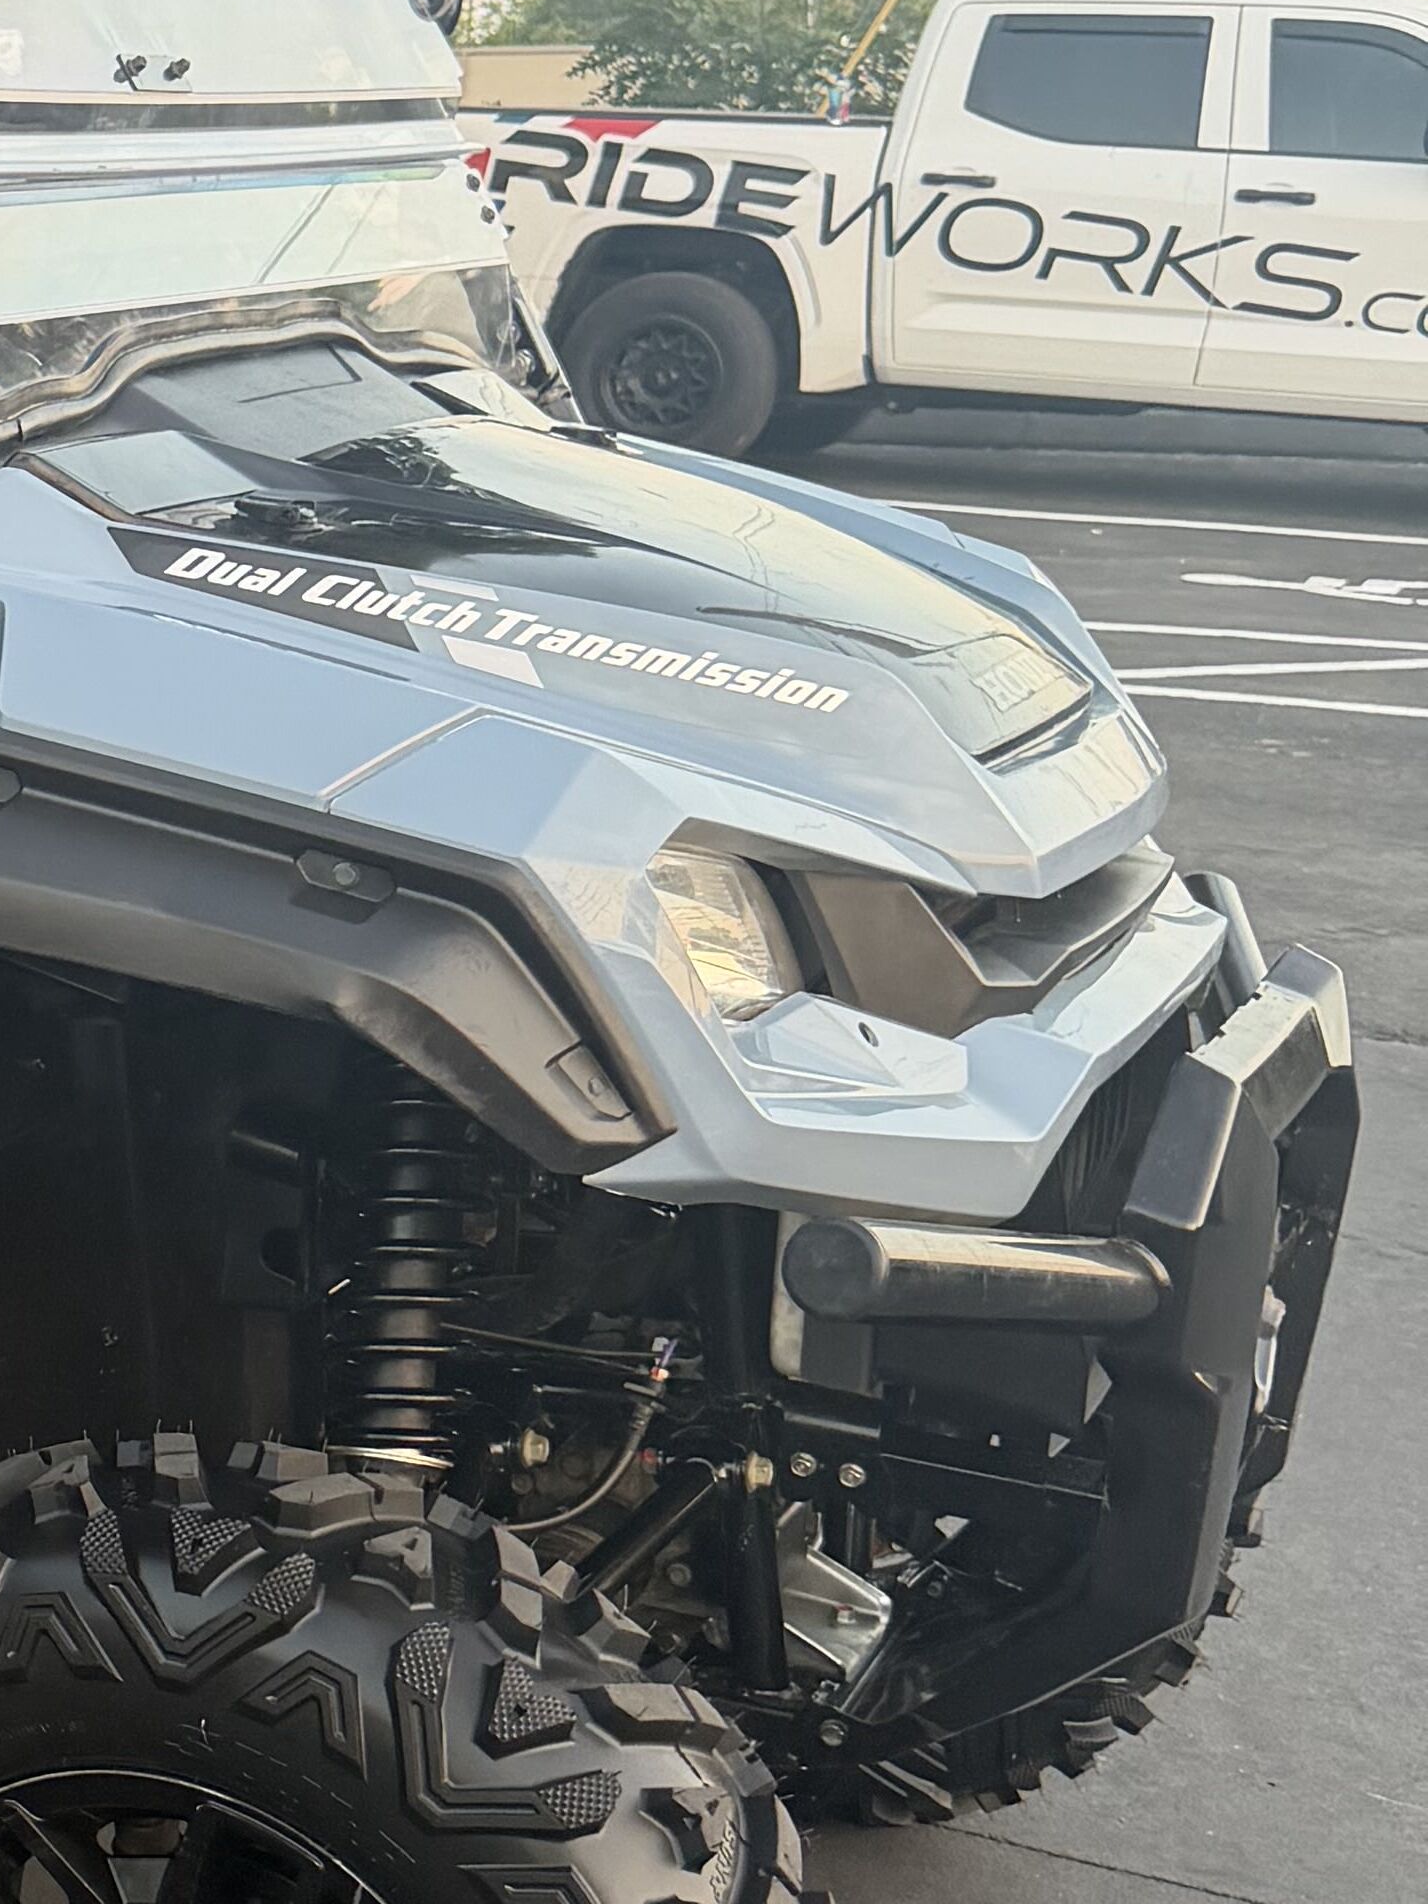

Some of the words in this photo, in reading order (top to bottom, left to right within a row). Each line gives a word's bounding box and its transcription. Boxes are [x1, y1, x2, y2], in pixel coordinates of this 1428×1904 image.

[163, 547, 308, 596] Dual
[301, 573, 482, 633] Clutch
[484, 607, 849, 714] Transmission
